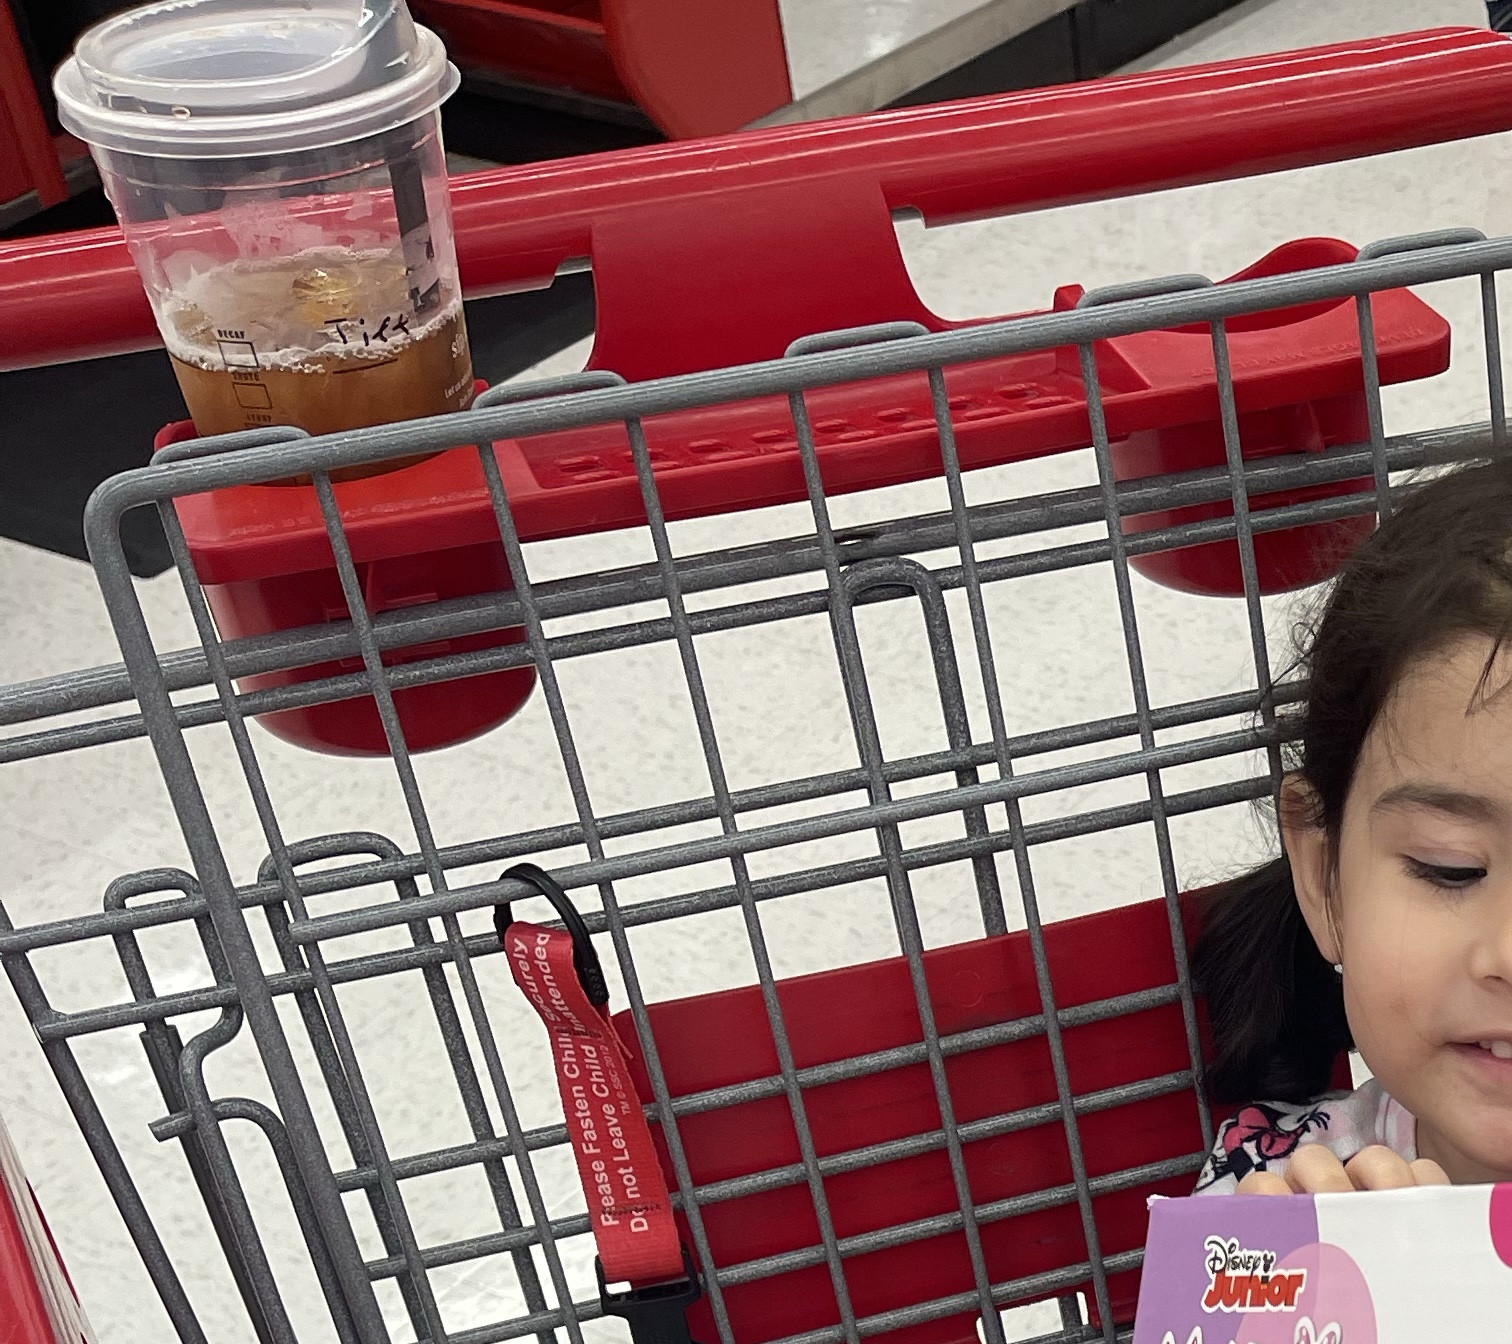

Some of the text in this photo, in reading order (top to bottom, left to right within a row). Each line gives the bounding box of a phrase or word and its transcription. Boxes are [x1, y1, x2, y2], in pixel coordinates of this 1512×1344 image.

[513, 938, 561, 1022] Securely
[580, 1044, 610, 1098] Child
[572, 1085, 601, 1155] Fasten
[602, 1103, 630, 1162] Leave
[617, 1166, 641, 1199] not
